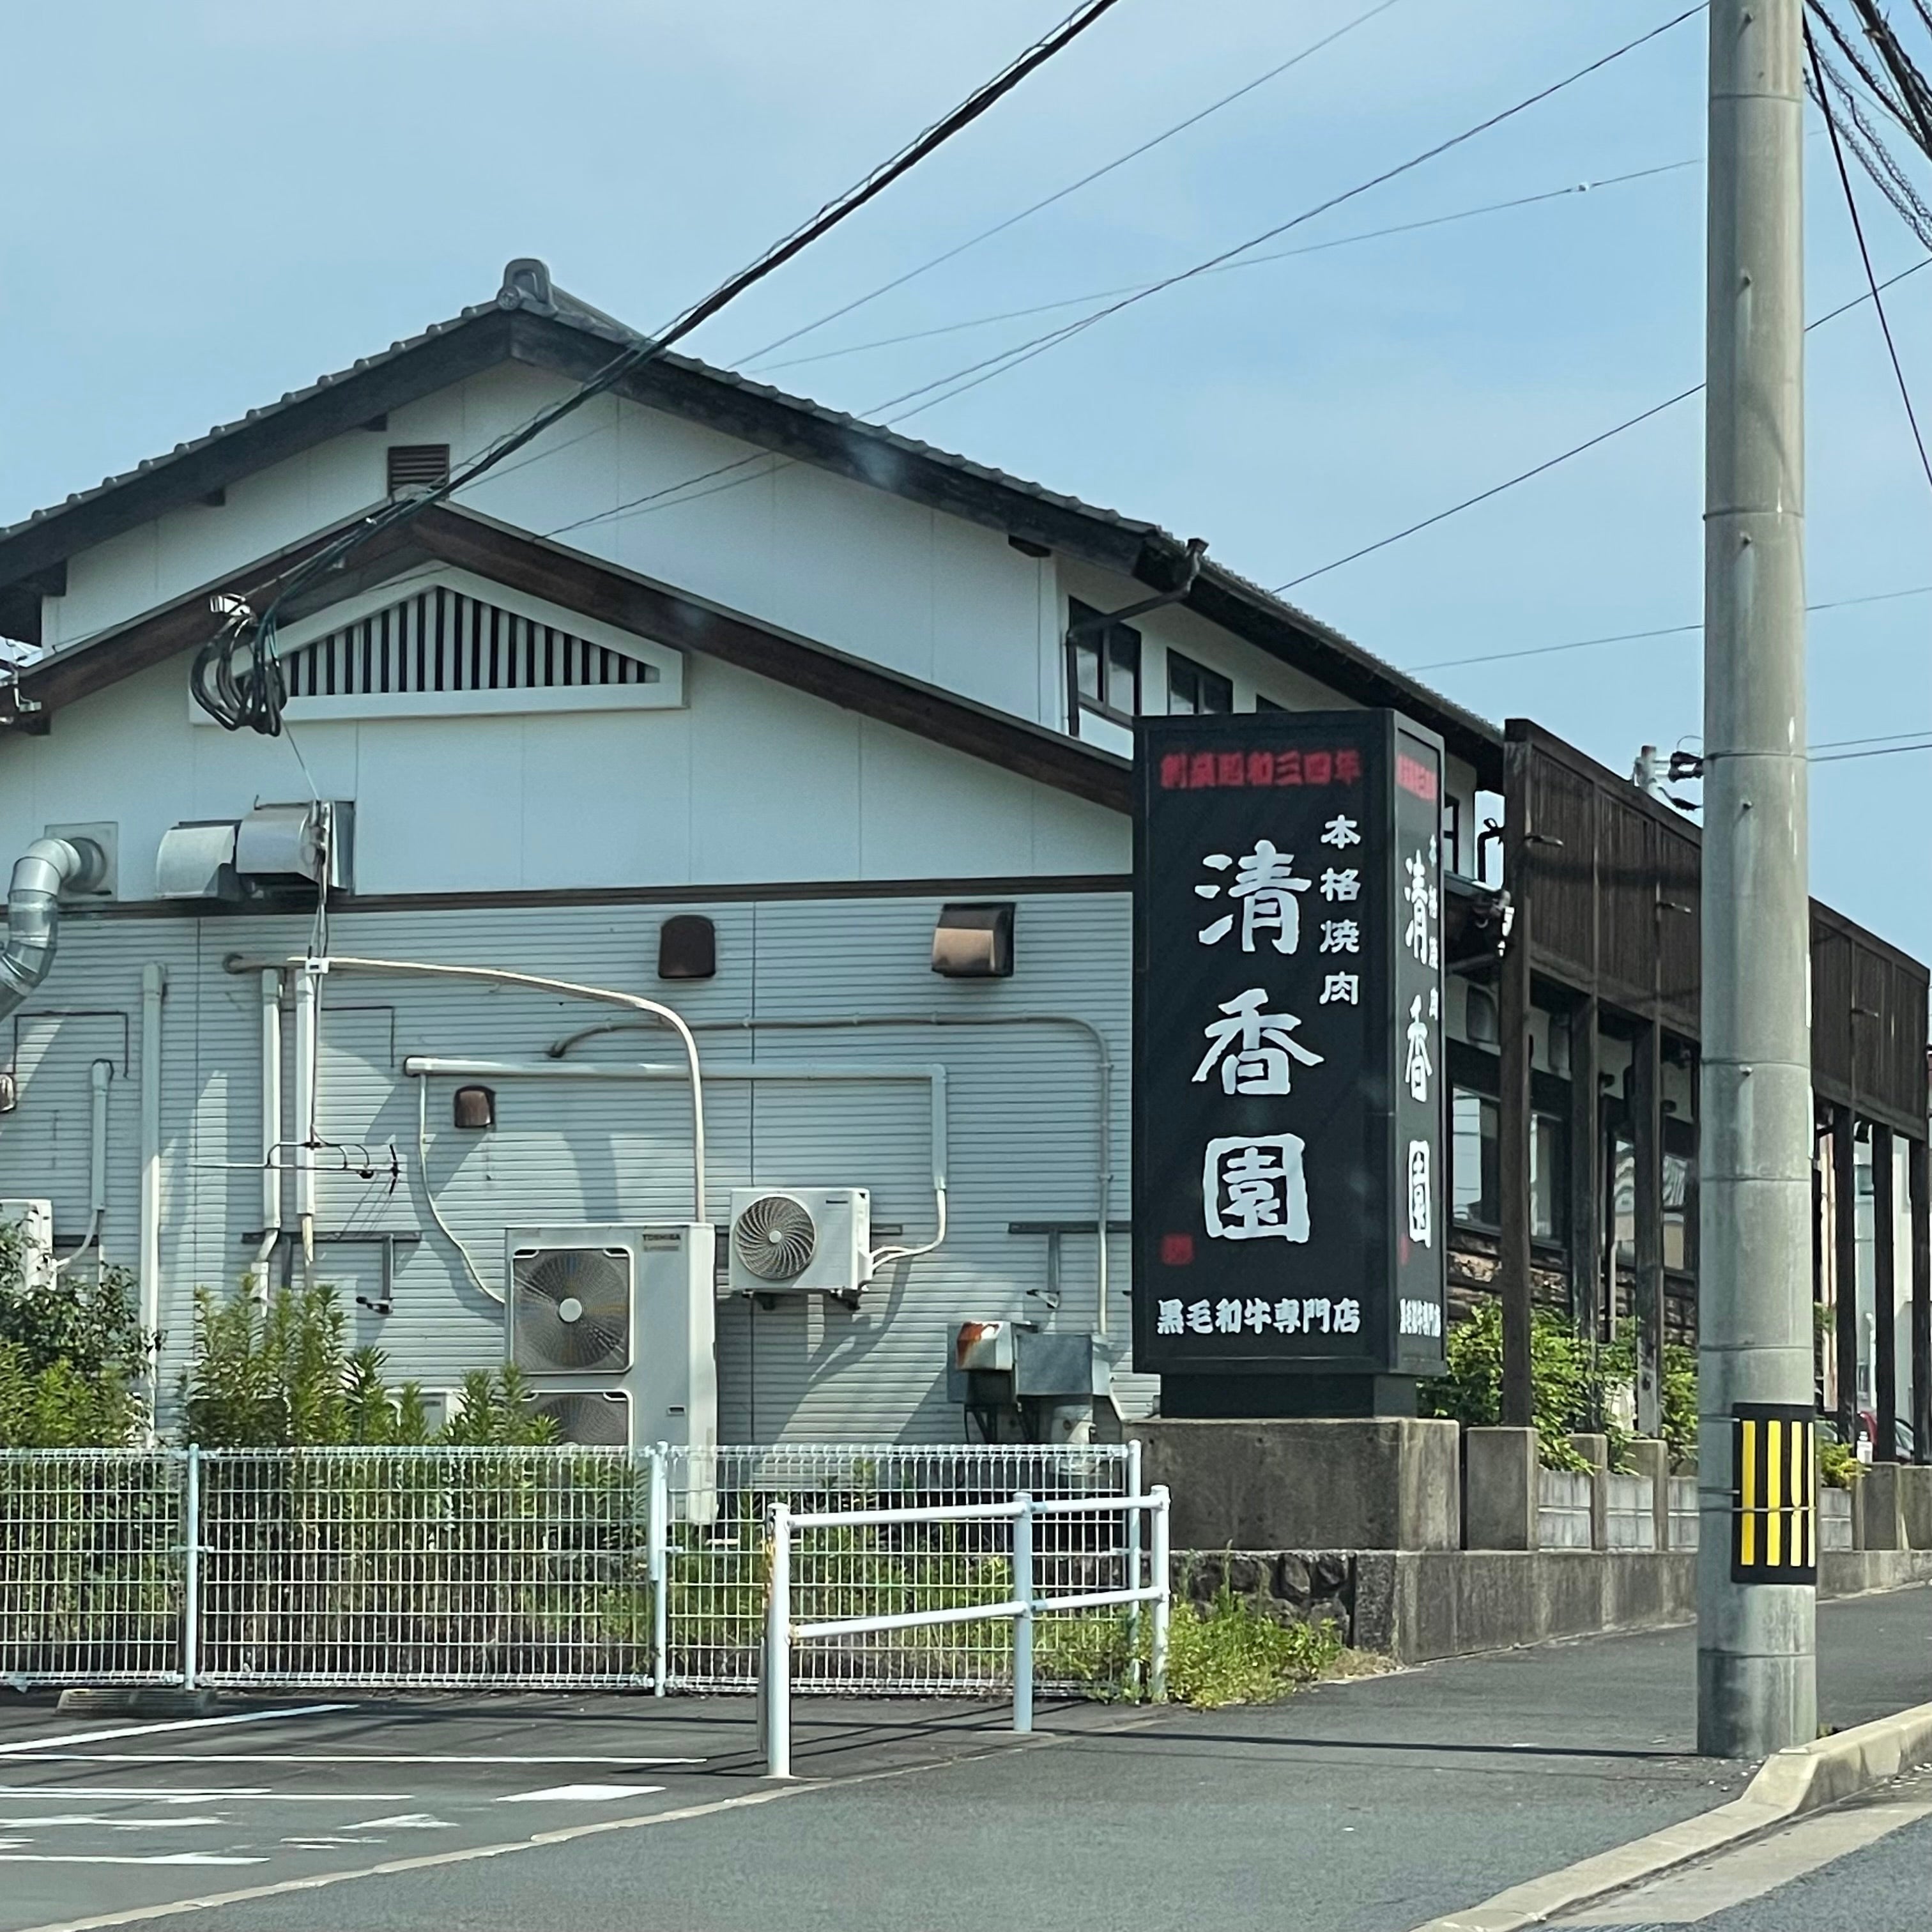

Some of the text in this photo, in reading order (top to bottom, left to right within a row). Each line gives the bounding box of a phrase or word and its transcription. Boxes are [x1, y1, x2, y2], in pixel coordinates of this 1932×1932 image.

[1192, 839, 1324, 1244] 清香園
[1320, 815, 1361, 1006] 本格焼肉
[1405, 849, 1432, 1248] 清香園
[1157, 1298, 1361, 1335] 黒毛和牛専門店
